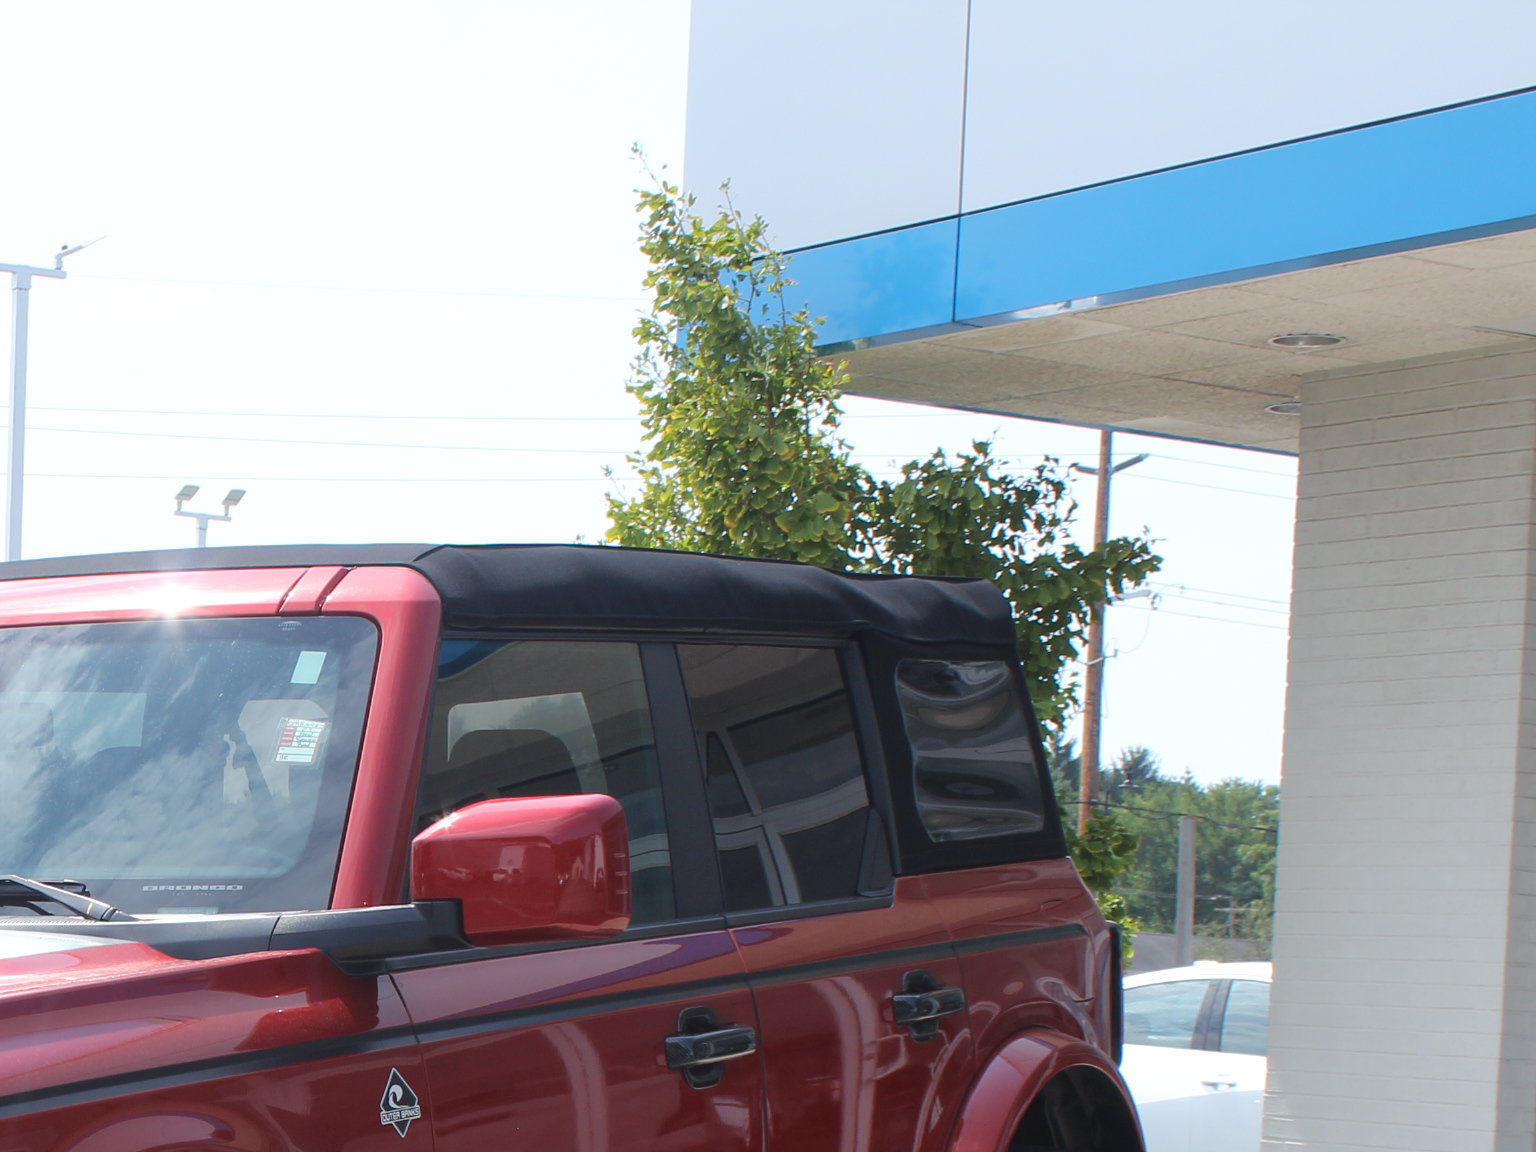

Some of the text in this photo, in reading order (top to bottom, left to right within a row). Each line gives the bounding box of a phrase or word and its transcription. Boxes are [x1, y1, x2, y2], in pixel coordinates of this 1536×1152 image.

[142, 884, 243, 892] BRONCO
[382, 1107, 419, 1122] OUTER BANKS
